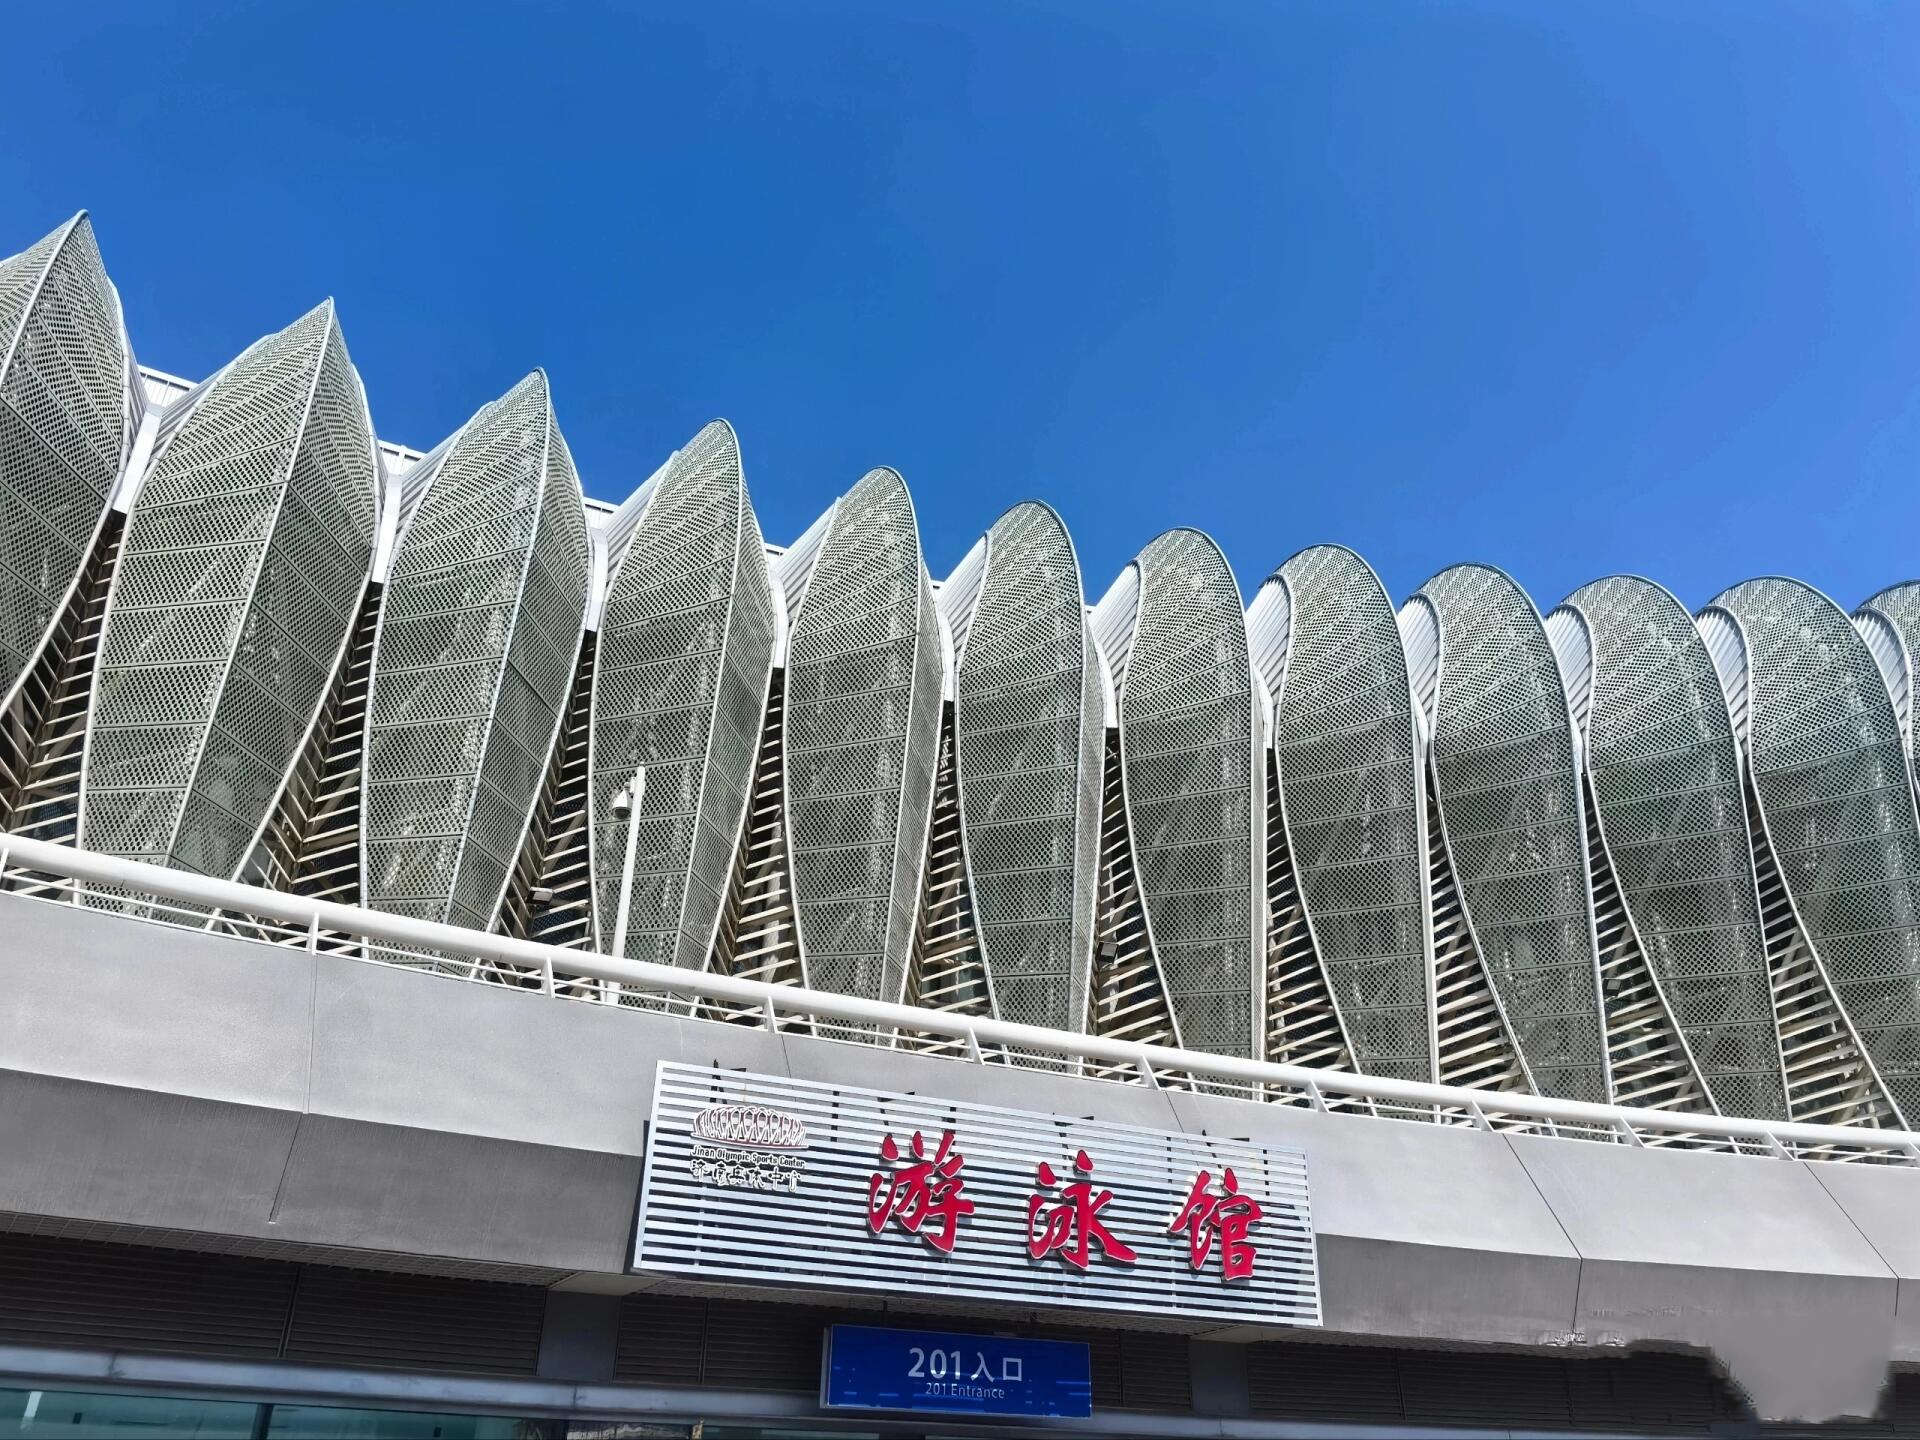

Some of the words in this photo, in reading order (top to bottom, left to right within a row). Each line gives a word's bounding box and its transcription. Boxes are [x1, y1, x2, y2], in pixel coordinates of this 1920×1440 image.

[692, 1146, 715, 1158] Jinan
[717, 1149, 750, 1163] Olympic
[752, 1152, 778, 1166] Sports
[779, 1156, 805, 1168] Center
[867, 1130, 1263, 1281] 游泳馆
[925, 1382, 947, 1395] 201
[950, 1383, 1006, 1399] Entrance
